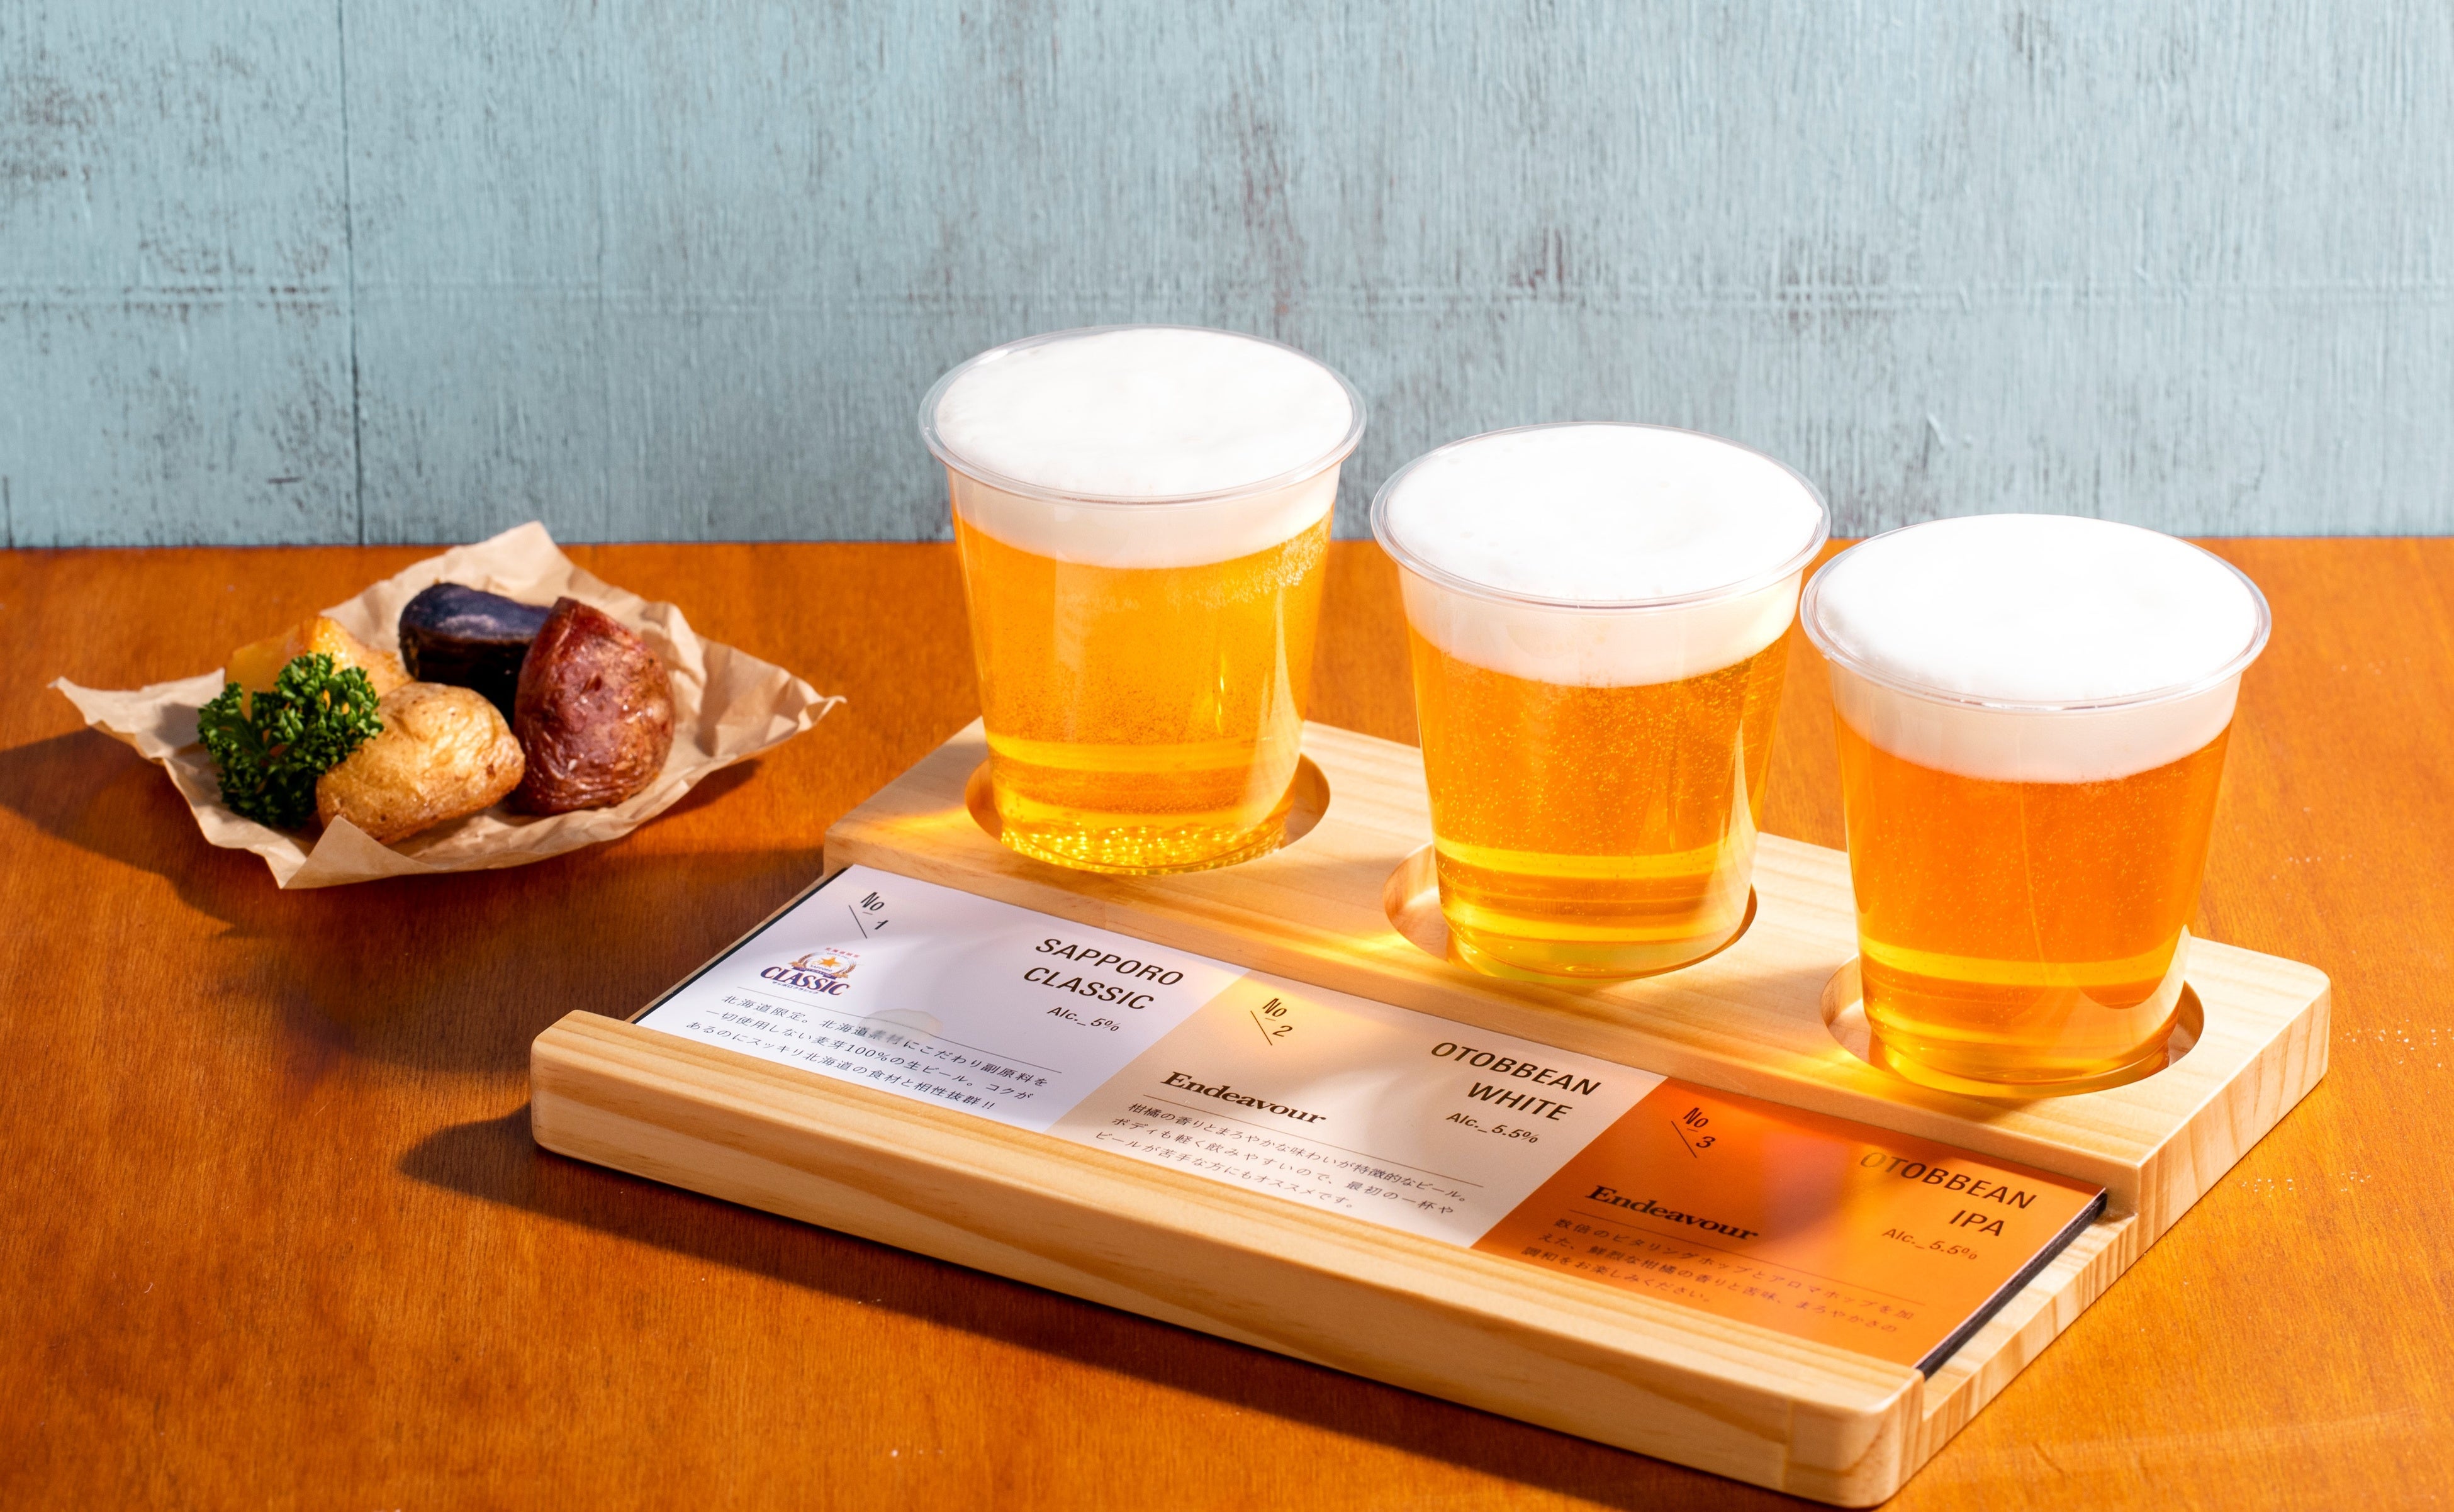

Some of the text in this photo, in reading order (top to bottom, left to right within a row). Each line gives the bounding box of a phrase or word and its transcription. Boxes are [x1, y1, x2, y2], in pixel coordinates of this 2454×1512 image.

[860, 892, 885, 910] No
[874, 919, 888, 930] 1
[1035, 939, 1184, 985] SAPPORO
[760, 966, 850, 995] CLASSIC
[1024, 967, 1154, 1009] CLASSIC
[1262, 998, 1287, 1017] No
[1272, 1025, 1292, 1037] 2
[1431, 1043, 1601, 1095] OTOBBEAN
[1160, 1071, 1326, 1124] Endeavour
[1467, 1082, 1572, 1121] WHITE
[1683, 1107, 1708, 1128] No
[1696, 1136, 1716, 1148] 3
[1861, 1152, 2037, 1209] OTOBBEAN
[1584, 1185, 1758, 1240] Endeavour
[1949, 1210, 2004, 1236] IPA
